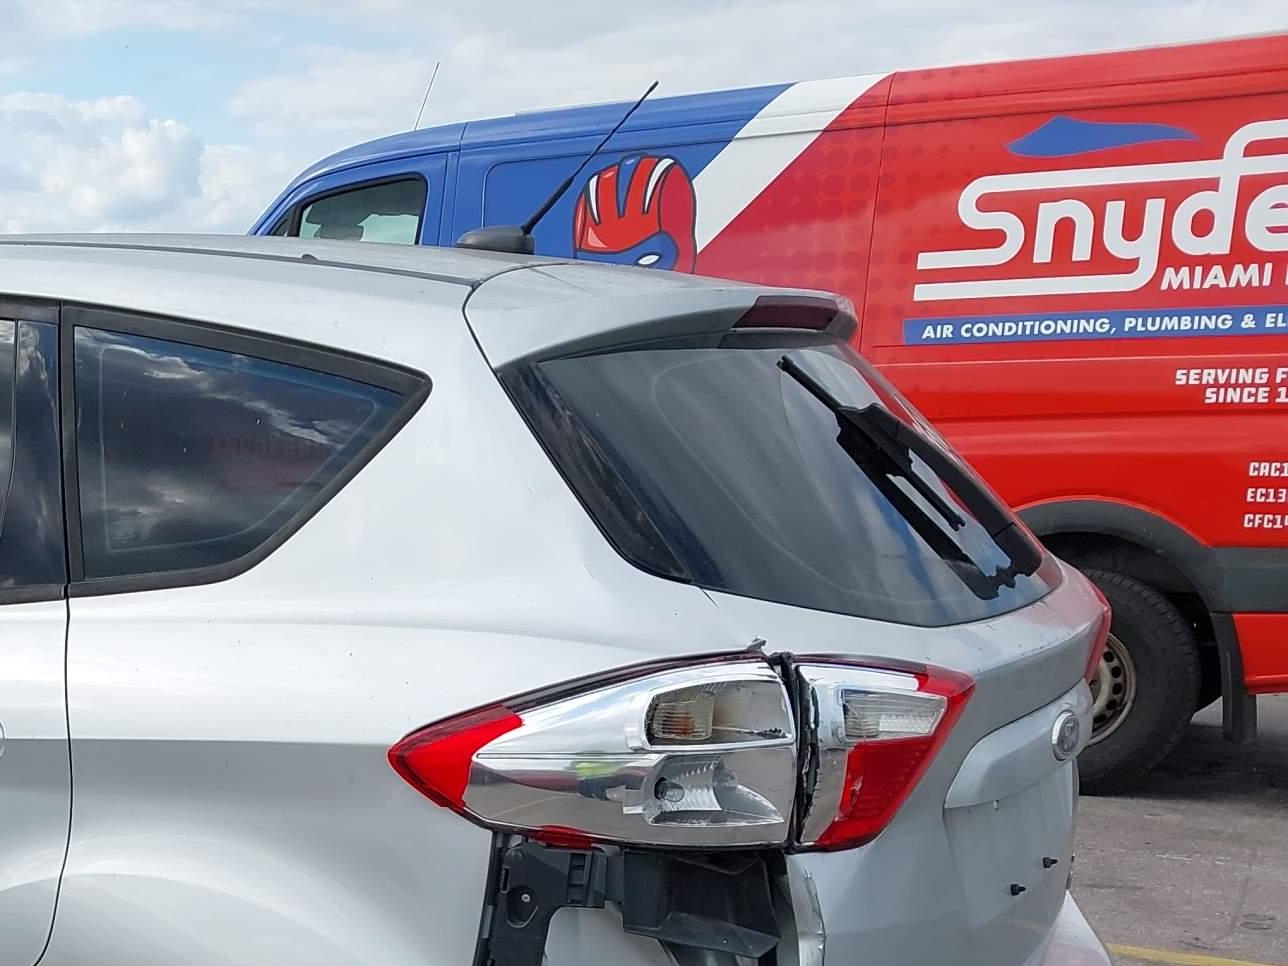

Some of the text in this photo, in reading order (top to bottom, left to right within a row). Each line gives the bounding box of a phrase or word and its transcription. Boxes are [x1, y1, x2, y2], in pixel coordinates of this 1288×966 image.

[1160, 262, 1273, 291] MIAMI
[922, 312, 1288, 340] AIR CONDITIONING, PLUMBING & EL
[1175, 367, 1270, 385] SERVING
[1204, 387, 1270, 404] SINCE
[1248, 462, 1288, 477] CAC1
